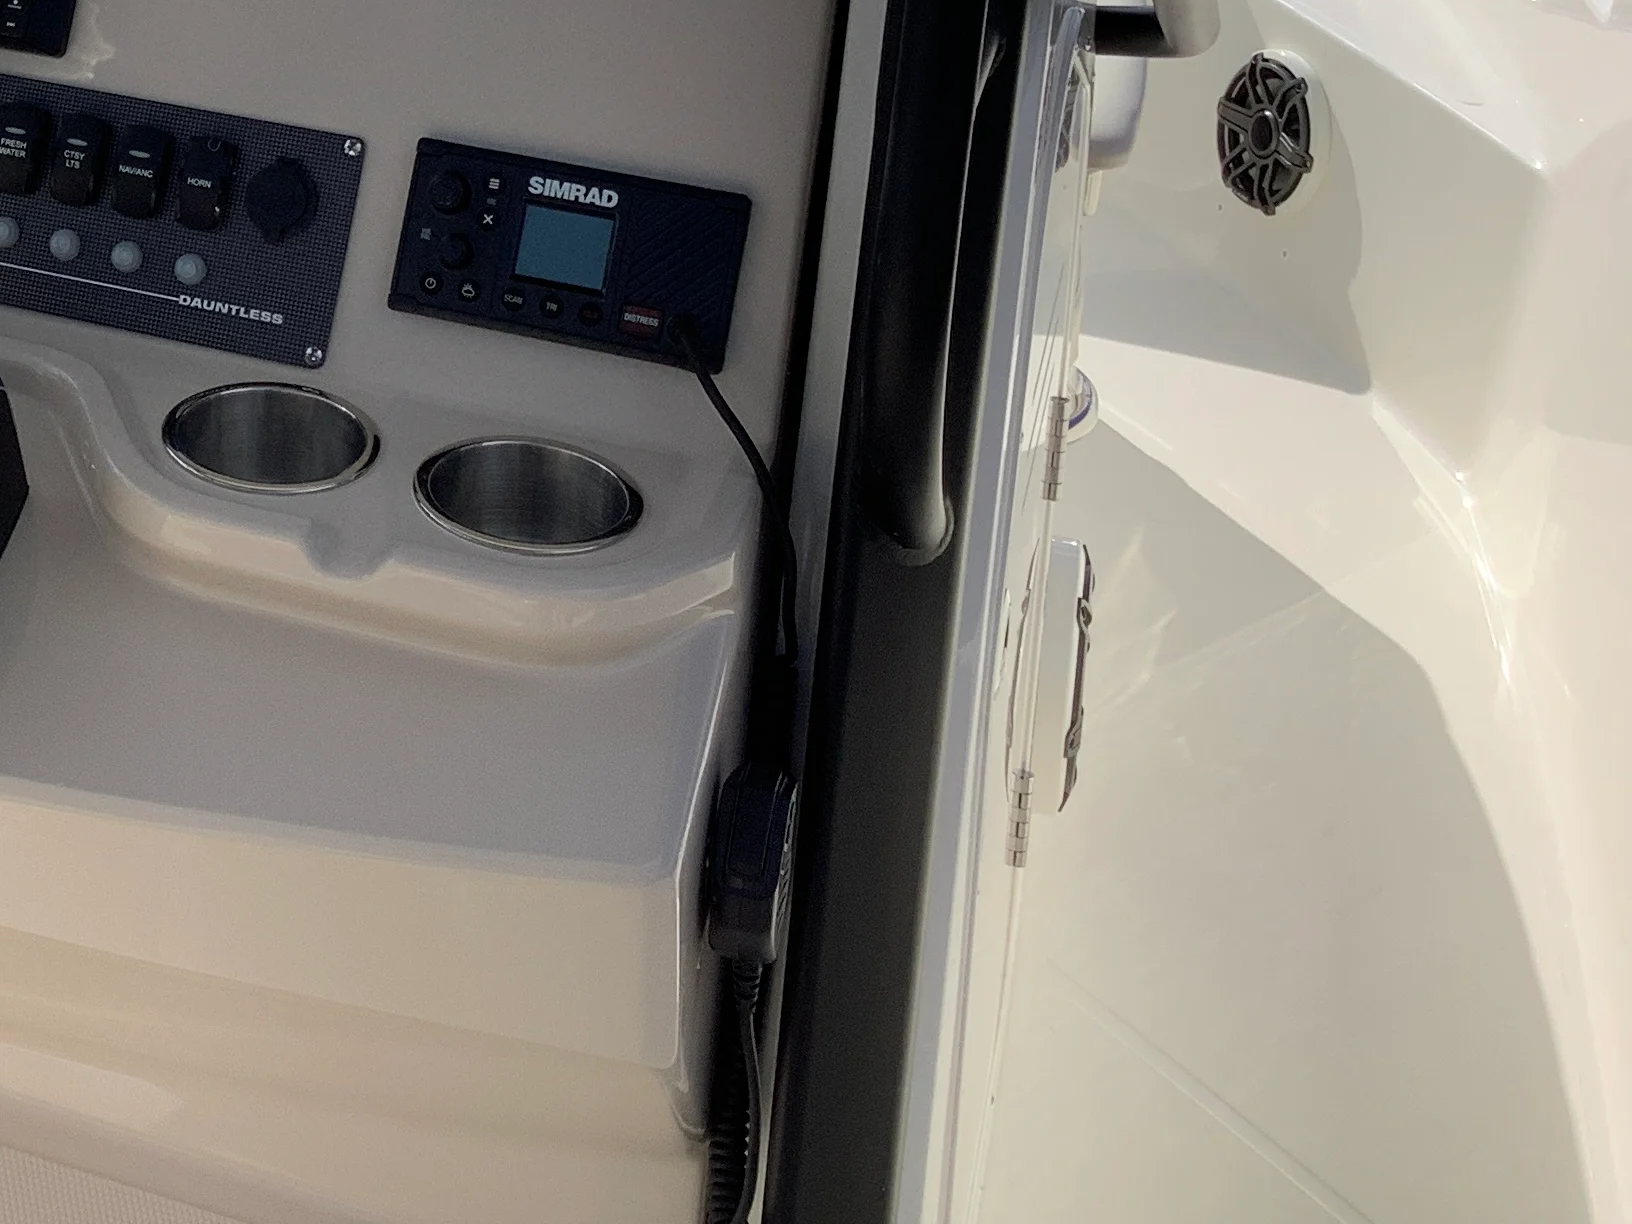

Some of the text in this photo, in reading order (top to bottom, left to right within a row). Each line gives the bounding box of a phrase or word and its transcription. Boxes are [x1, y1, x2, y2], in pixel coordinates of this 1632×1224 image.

[0, 137, 27, 150] FRESH
[63, 149, 85, 161] CTSY
[65, 159, 80, 169] LTS
[118, 164, 153, 178] NAV/ANC
[187, 176, 212, 188] HORN
[528, 176, 619, 208] SIMRAD
[179, 295, 283, 324] DAUNTLESS
[624, 312, 659, 327] DISTRESS
